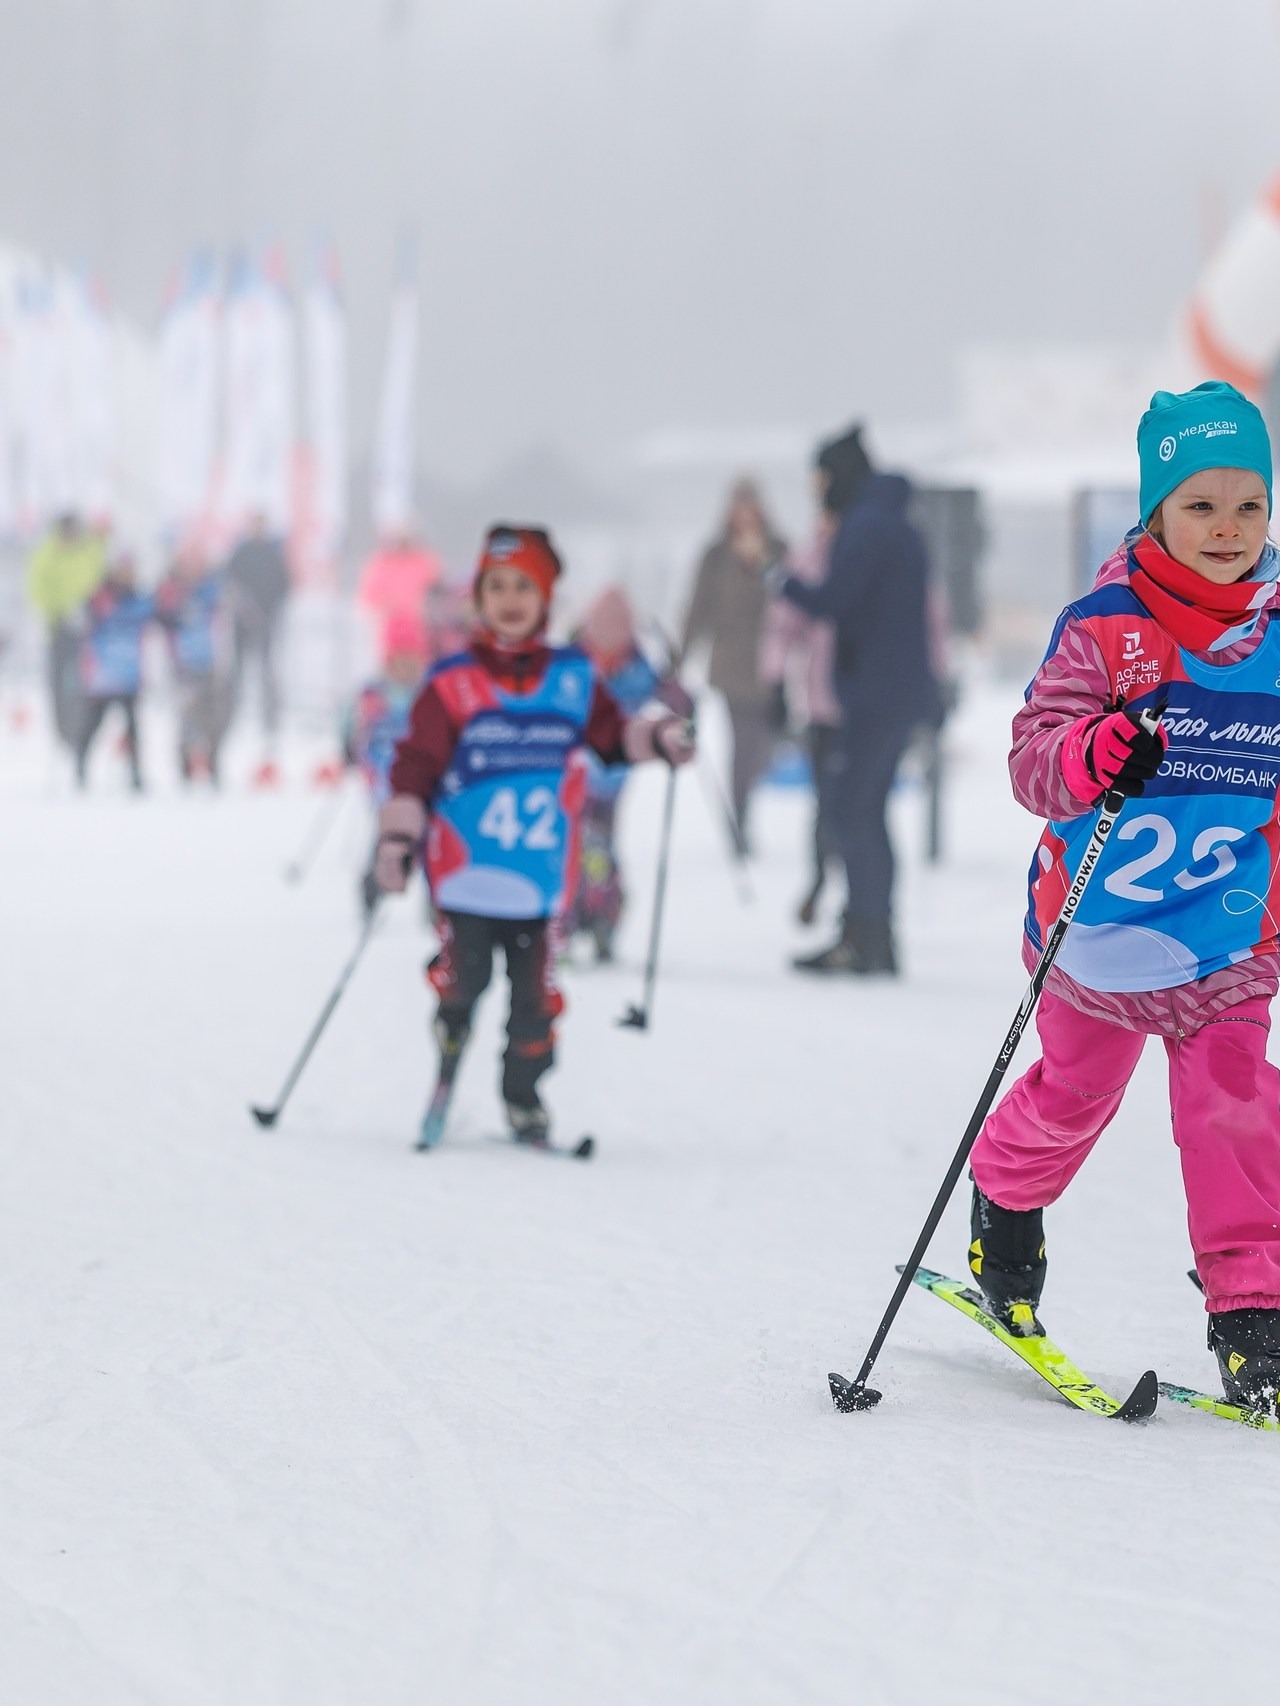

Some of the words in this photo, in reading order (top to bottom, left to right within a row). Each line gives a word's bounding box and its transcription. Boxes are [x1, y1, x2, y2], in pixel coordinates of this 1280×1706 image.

[1156, 760, 1278, 789] ОВКОМБАНК
[478, 787, 561, 851] 42
[1062, 843, 1099, 918] NORDWAY
[1008, 1015, 1024, 1045] ACTIVE
